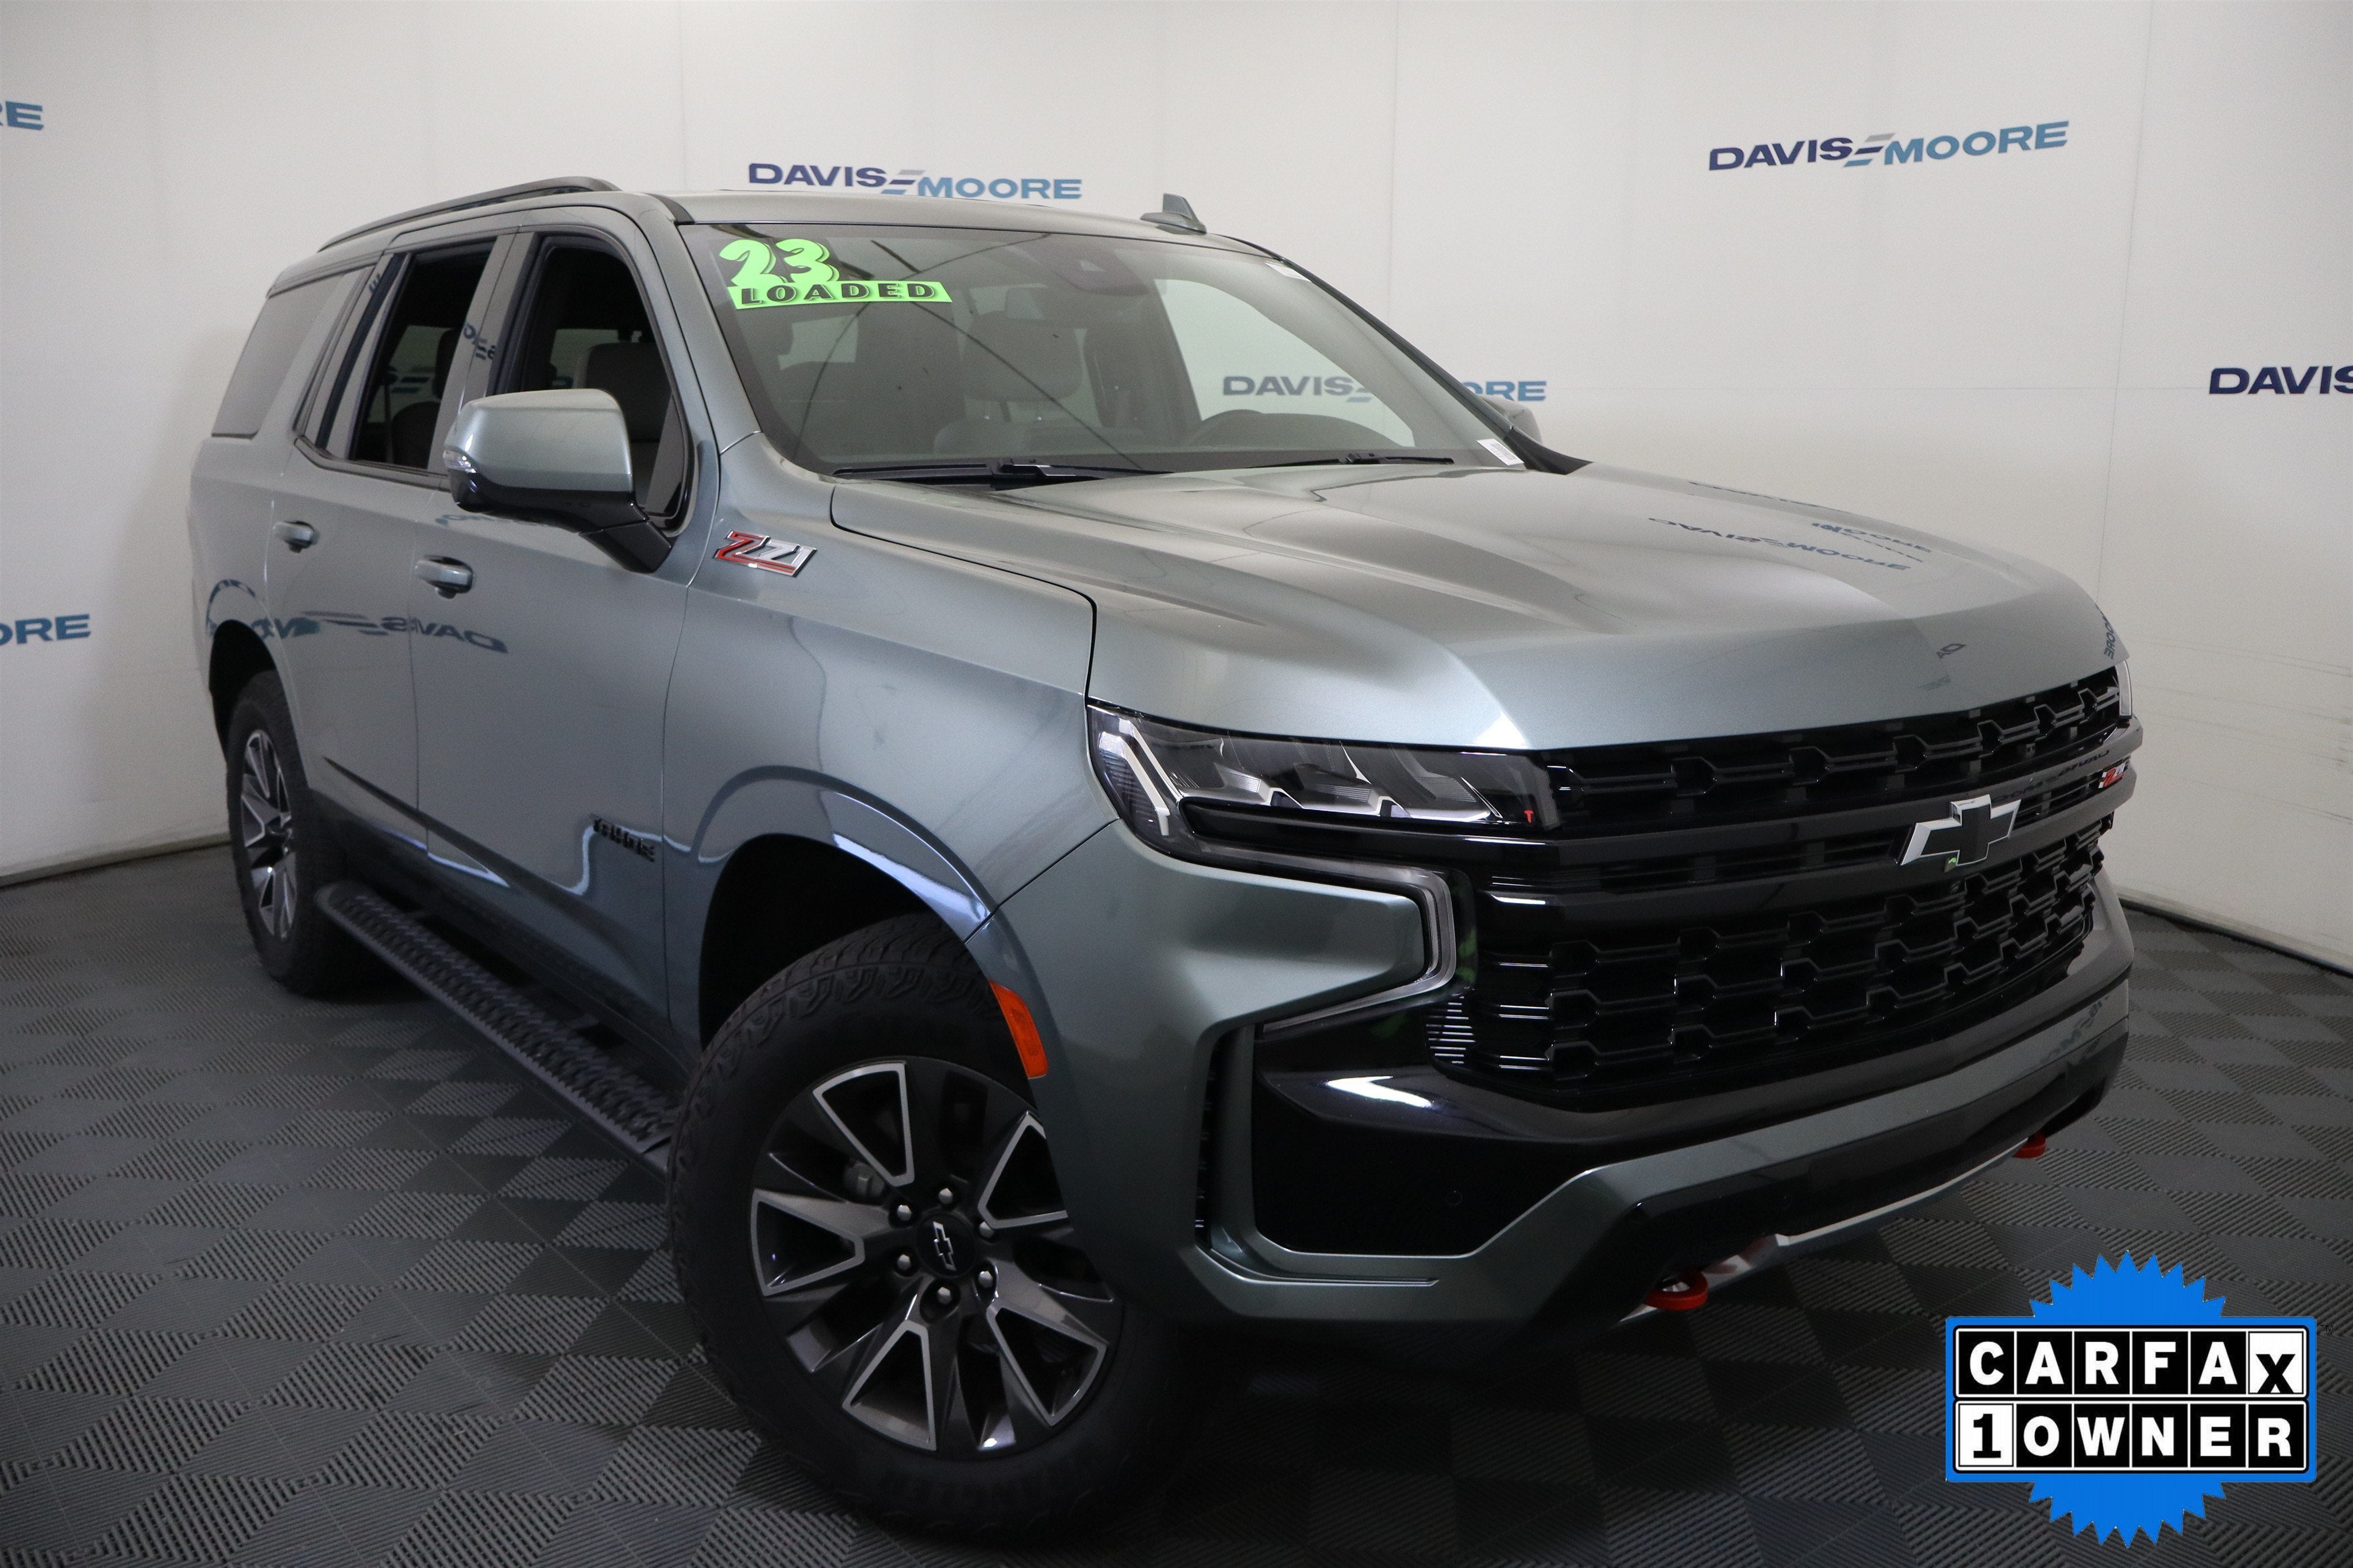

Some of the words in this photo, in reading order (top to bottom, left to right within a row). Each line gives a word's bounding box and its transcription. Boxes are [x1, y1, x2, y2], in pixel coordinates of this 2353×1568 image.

[1709, 137, 1854, 171] DAVIS
[1884, 121, 2069, 165] MOORE
[749, 163, 887, 187] DAVIS
[918, 176, 1082, 199] MOORE
[719, 238, 839, 283] 23
[741, 283, 938, 306] LOADED
[1222, 376, 1357, 396] DAVIS
[2209, 365, 2353, 395] DAVIS
[713, 530, 817, 577] Z71
